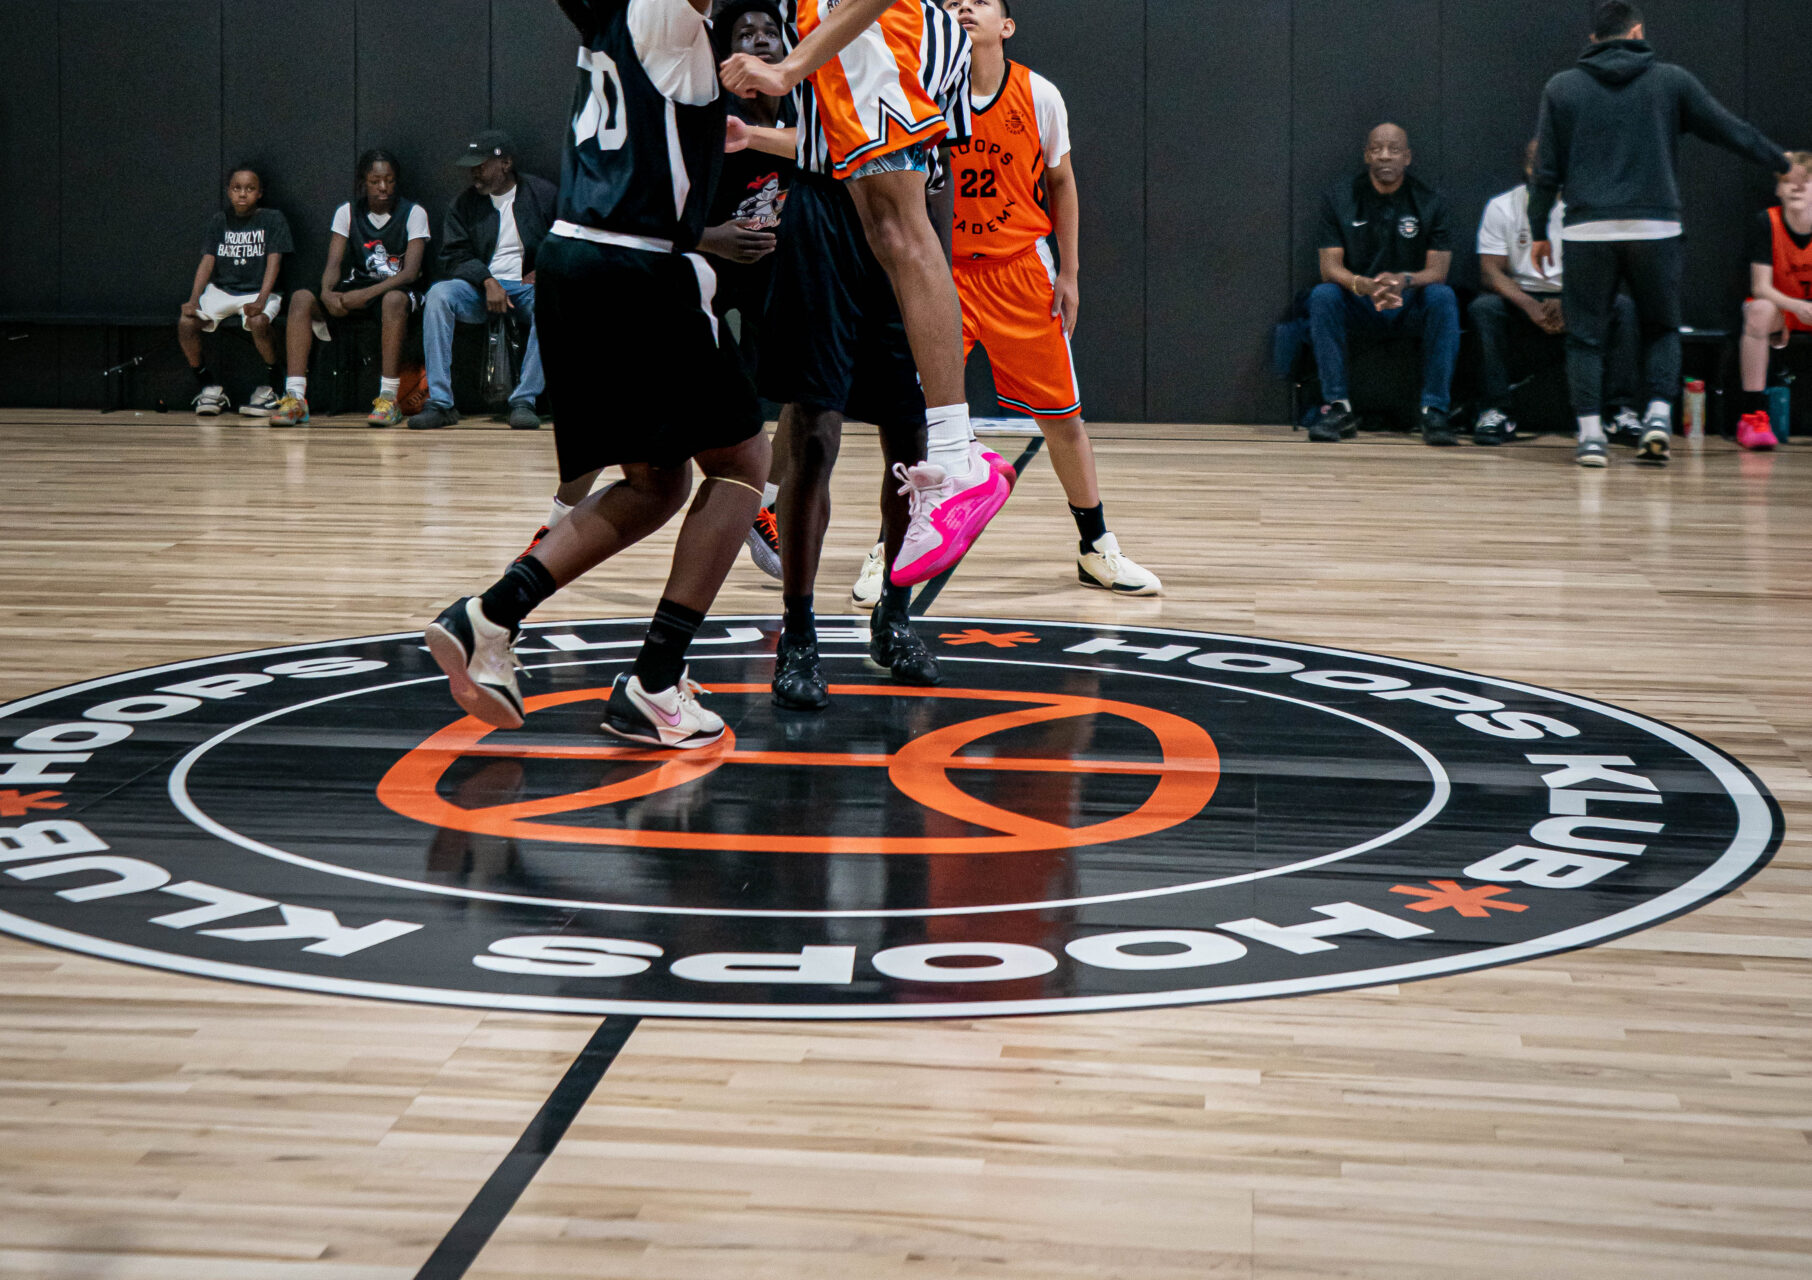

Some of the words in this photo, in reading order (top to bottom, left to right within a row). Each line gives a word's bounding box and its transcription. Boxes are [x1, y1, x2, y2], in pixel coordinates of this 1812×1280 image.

[950, 139, 1014, 166] OOPS
[960, 168, 997, 198] 22
[953, 198, 1016, 235] ADEMY
[0, 656, 389, 784] HOOPS
[1063, 637, 1582, 741] HOOPS
[1462, 753, 1667, 889] KLUB
[0, 819, 425, 958] KLUB
[472, 900, 1435, 985] HOOPS
